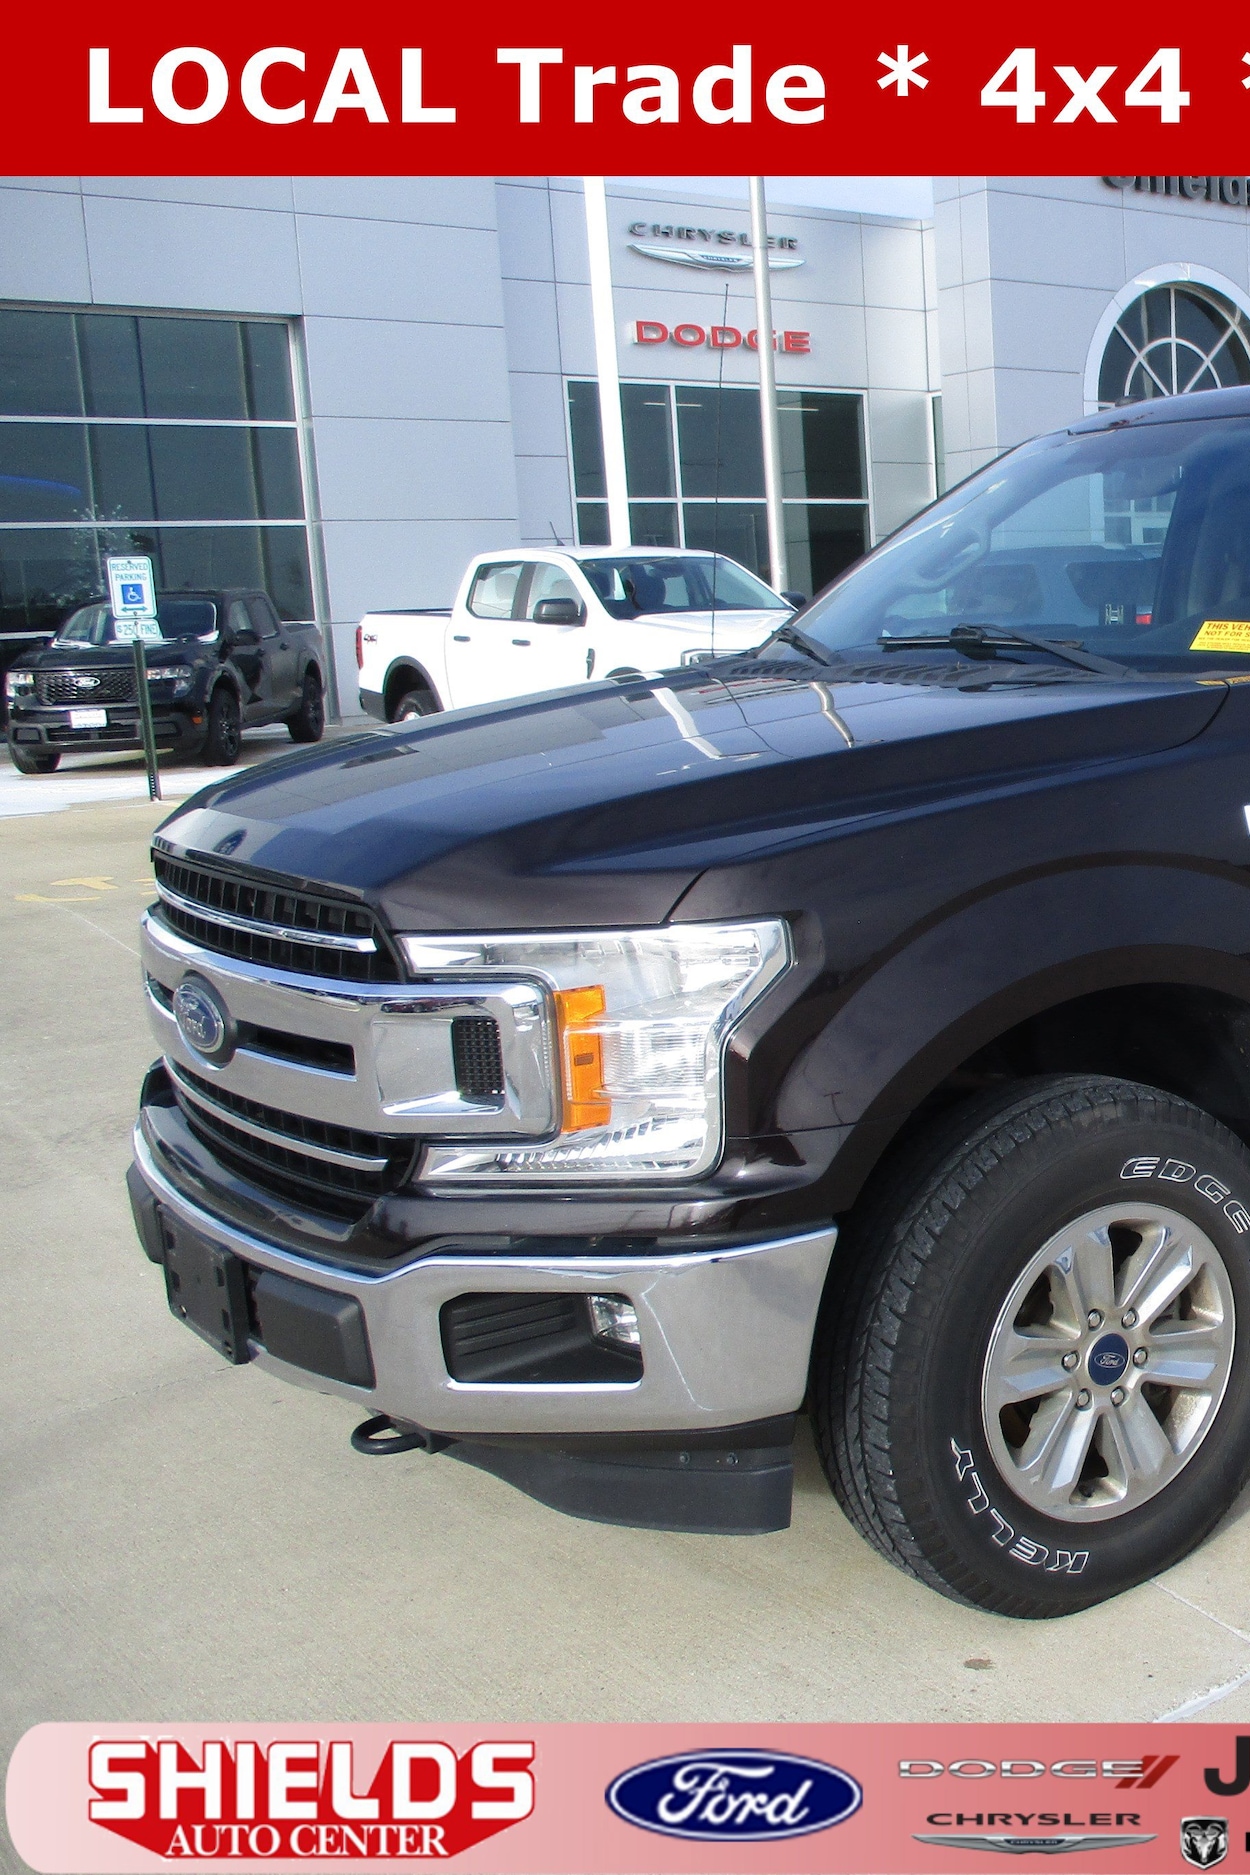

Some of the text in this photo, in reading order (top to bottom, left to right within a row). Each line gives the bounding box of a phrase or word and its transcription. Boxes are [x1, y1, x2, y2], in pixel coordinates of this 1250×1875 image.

[111, 562, 148, 571] RESERVED
[115, 573, 147, 582] PARKING
[140, 623, 157, 635] FINE
[1206, 622, 1229, 631] THIS
[1099, 1353, 1120, 1366] Ford
[950, 1437, 1090, 1575] KELLY
